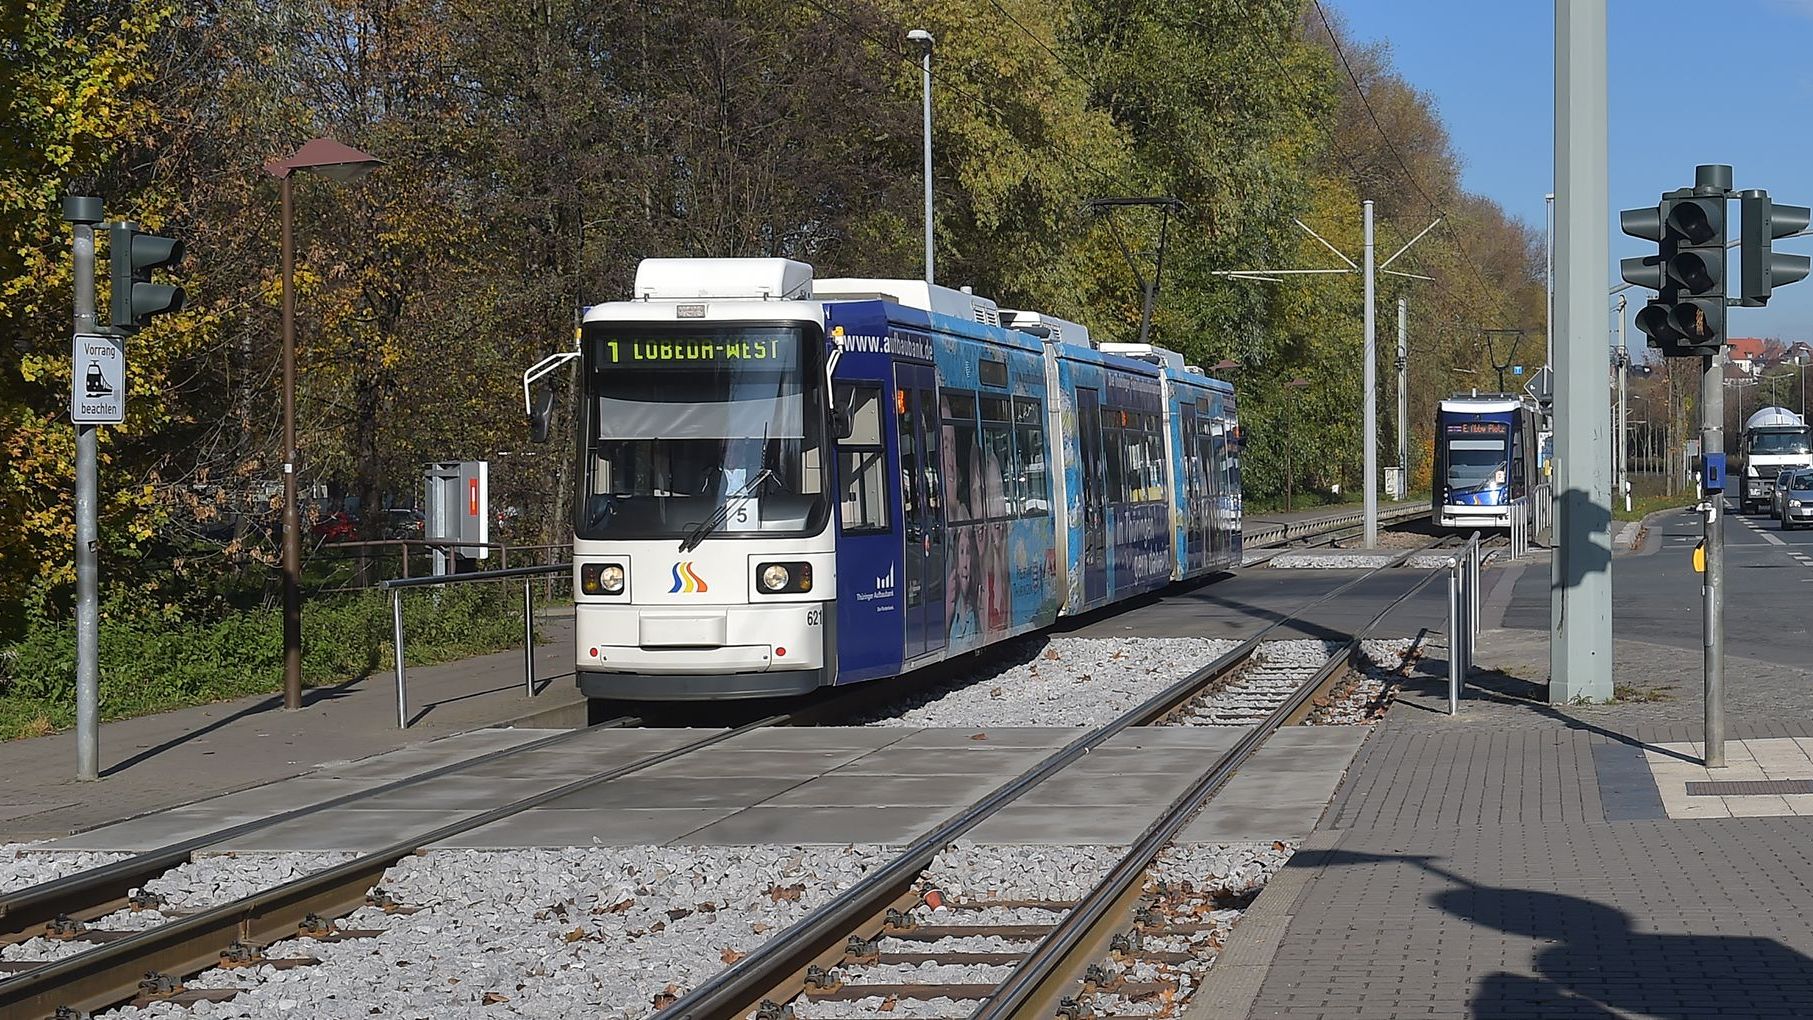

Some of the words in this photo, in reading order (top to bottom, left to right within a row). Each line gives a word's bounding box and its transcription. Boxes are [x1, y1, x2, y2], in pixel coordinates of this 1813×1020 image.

[84, 342, 116, 359] Vorrang
[607, 342, 619, 363] 1
[633, 338, 779, 360] LOBEDA-WEST
[81, 402, 117, 415] beachten
[736, 507, 748, 523] 5
[807, 610, 822, 626] 621
